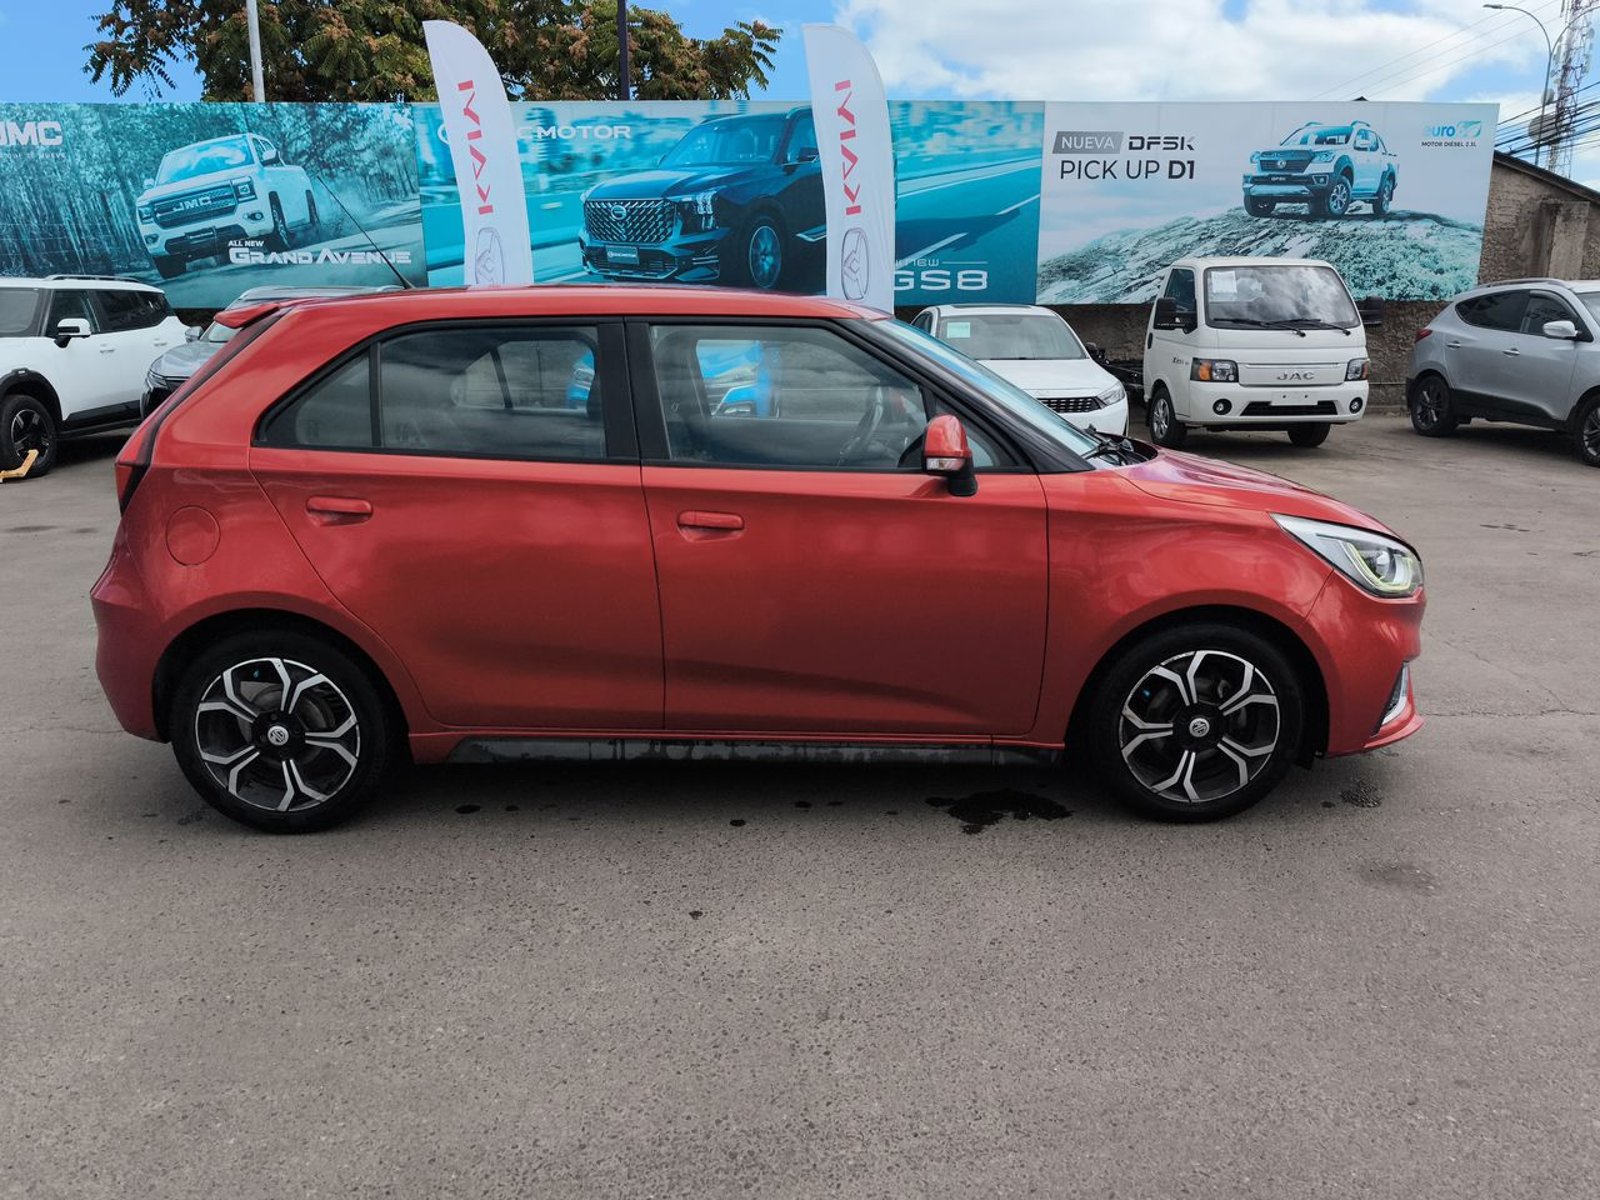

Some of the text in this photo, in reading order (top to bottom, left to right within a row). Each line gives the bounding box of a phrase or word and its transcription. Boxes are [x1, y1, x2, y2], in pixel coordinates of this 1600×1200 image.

[1061, 136, 1195, 151] NUEVA DFSK
[1060, 160, 1195, 180] PICK UP D1
[1276, 371, 1316, 381] JAC
